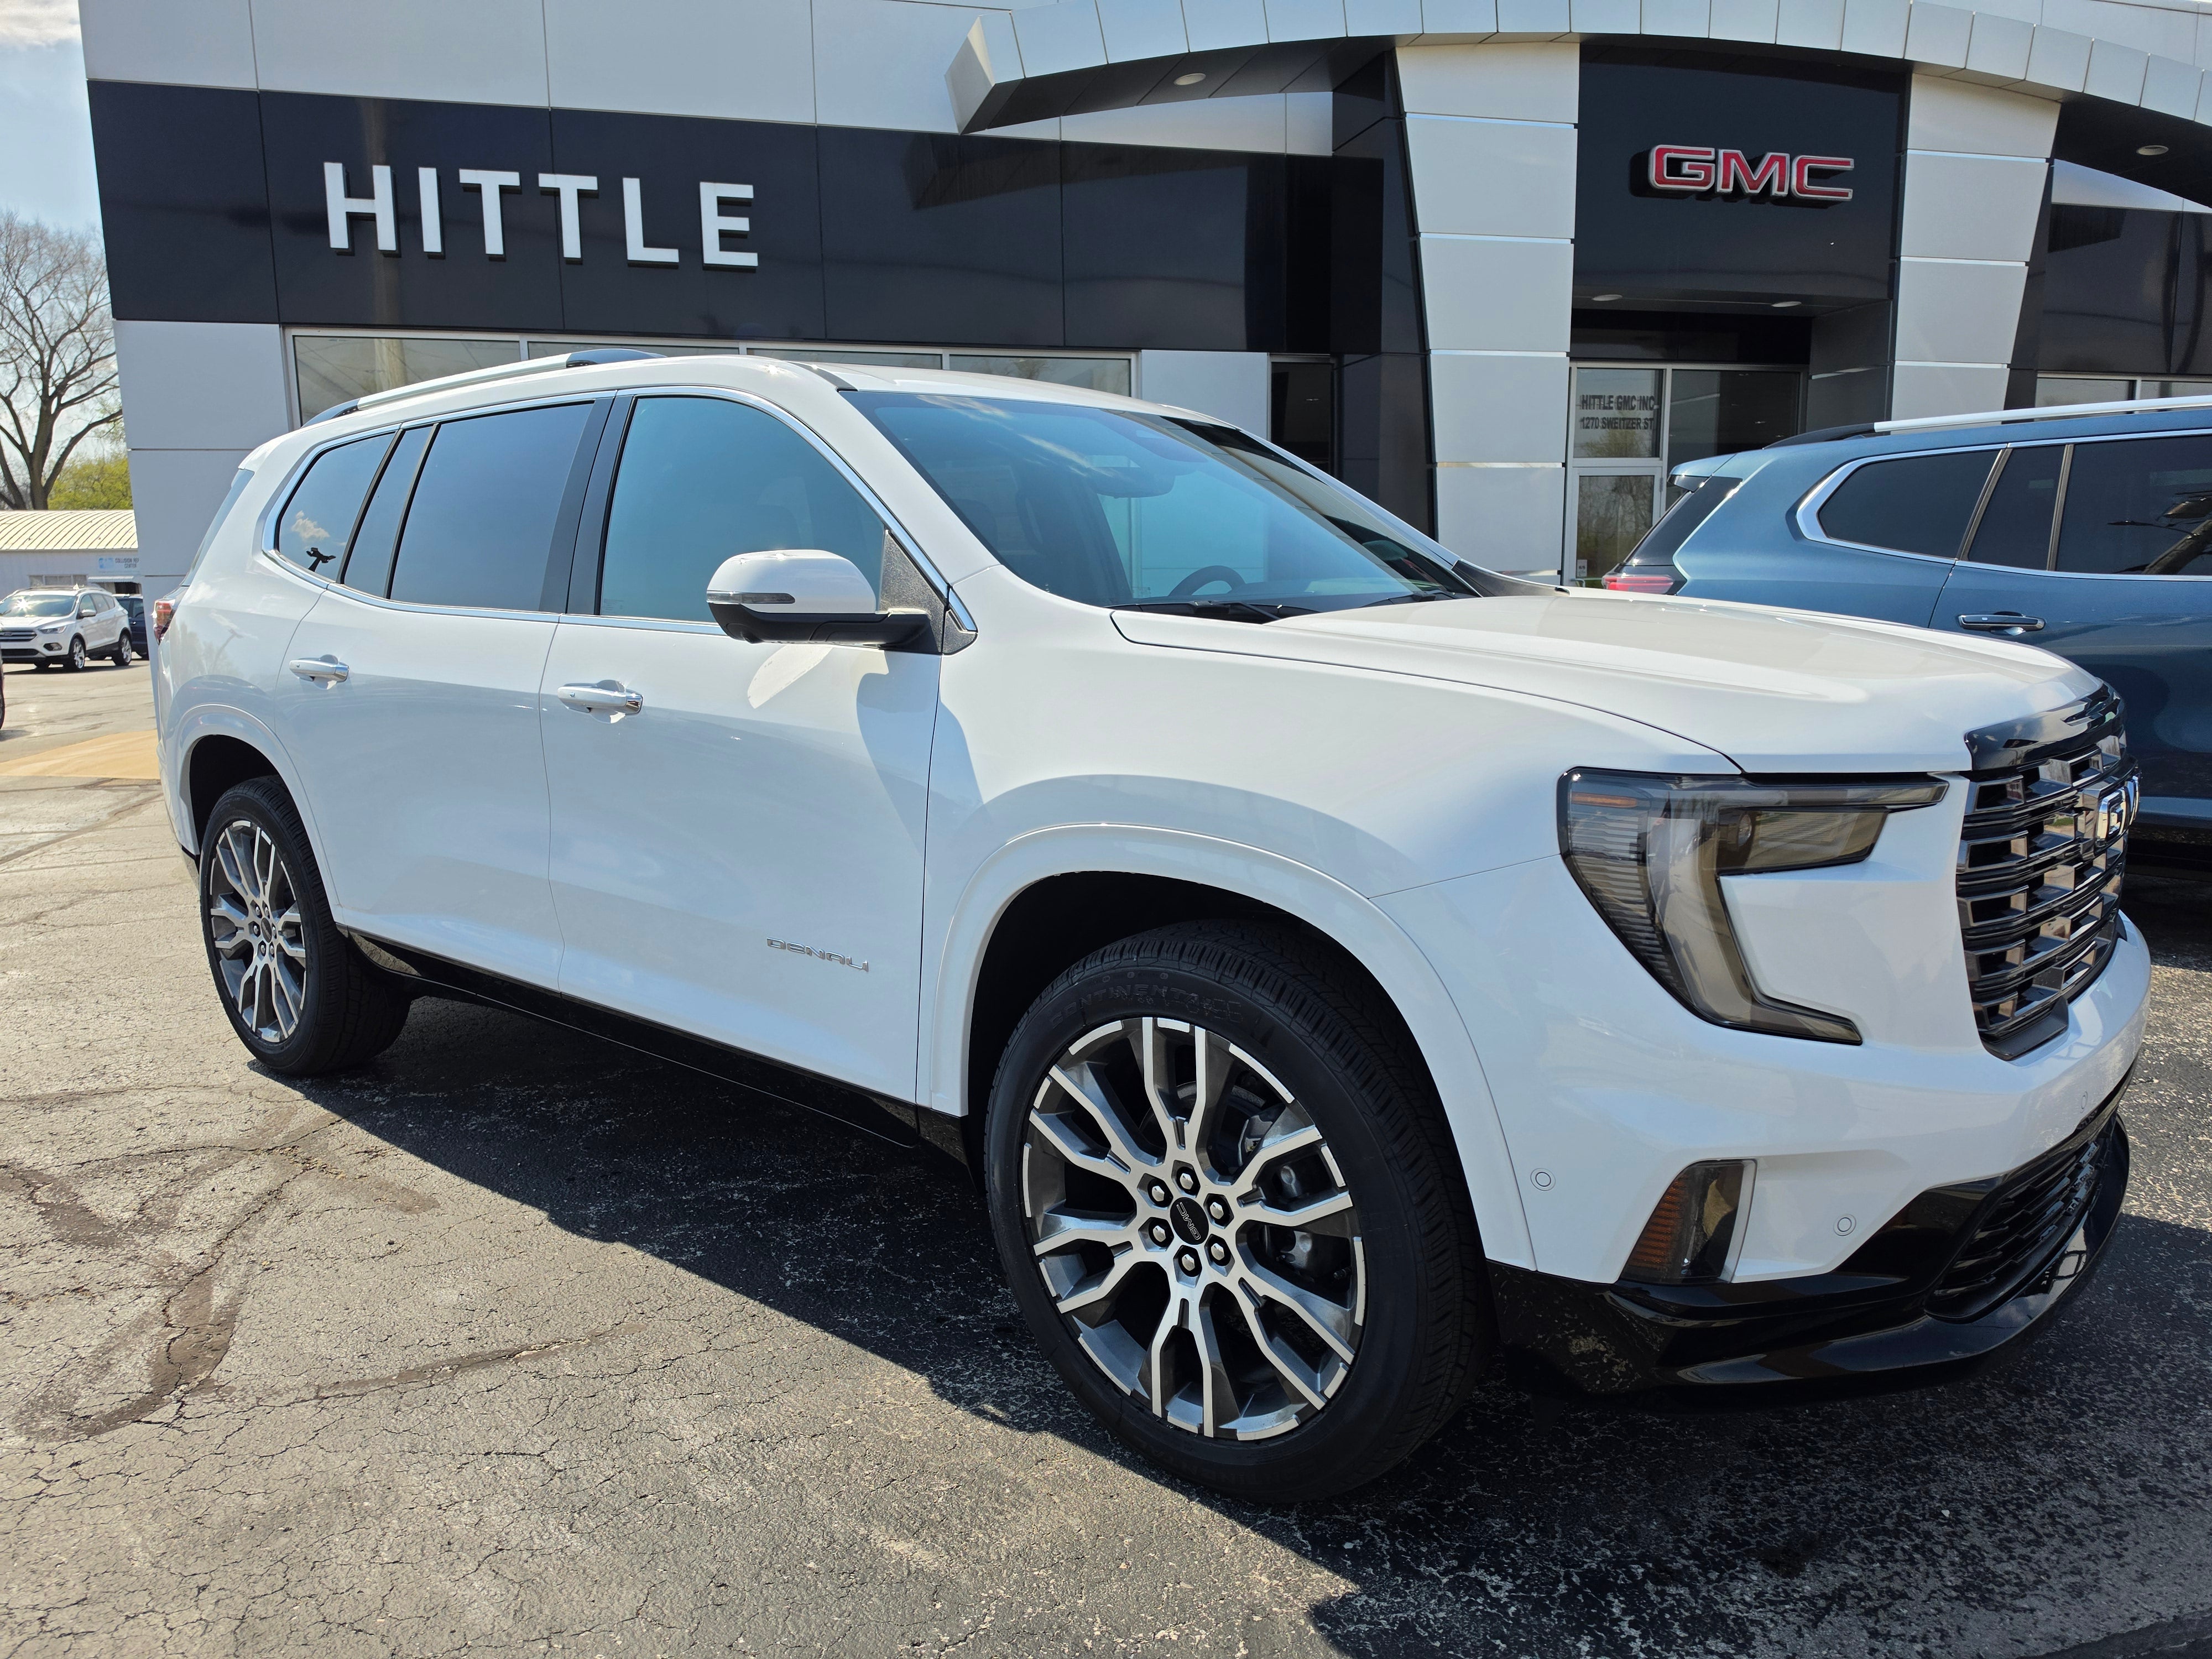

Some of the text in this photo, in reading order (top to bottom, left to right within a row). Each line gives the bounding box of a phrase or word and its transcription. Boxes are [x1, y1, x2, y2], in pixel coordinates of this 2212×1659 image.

[1648, 145, 1854, 201] GMC
[324, 162, 758, 268] HITTLE
[1582, 395, 1655, 411] HITTLE GMC INC
[1580, 416, 1654, 430] 1270 SWEITZER ST
[766, 937, 869, 972] DENALI
[1176, 1202, 1201, 1240] GMC
